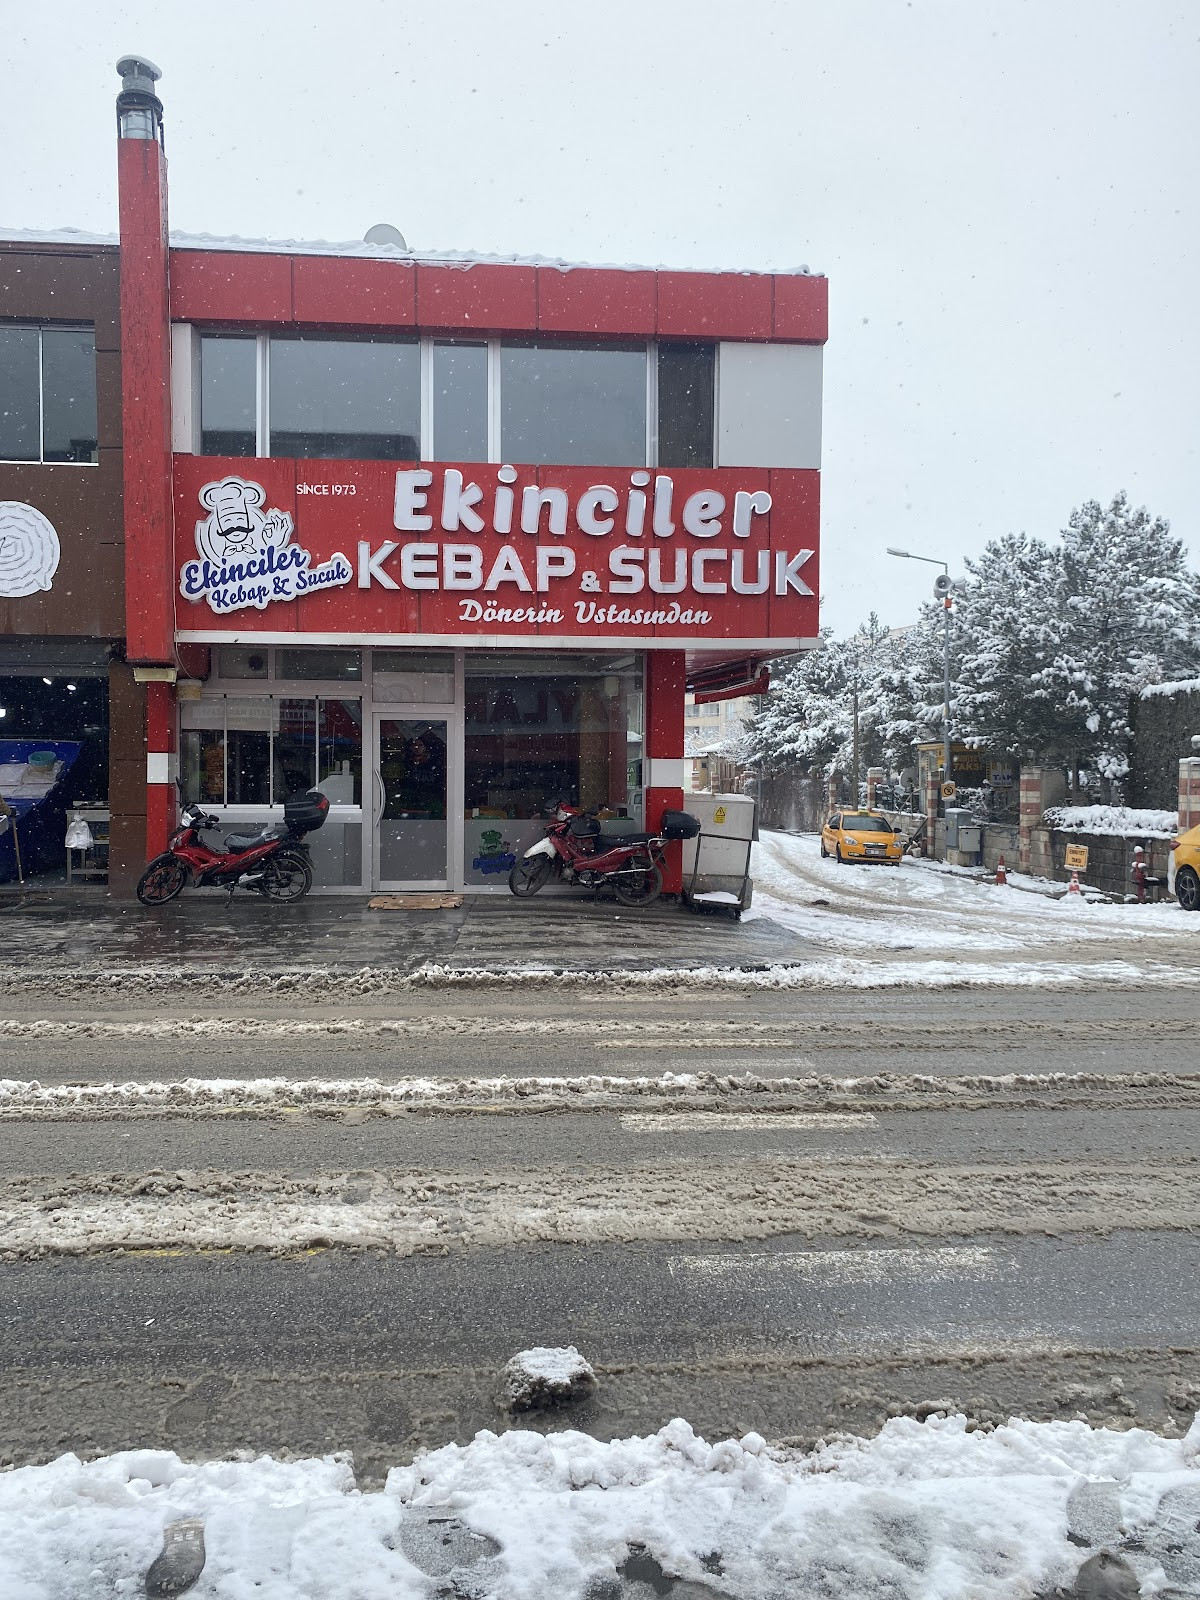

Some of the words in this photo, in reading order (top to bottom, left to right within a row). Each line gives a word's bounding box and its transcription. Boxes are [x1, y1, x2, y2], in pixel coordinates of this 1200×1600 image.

[332, 484, 356, 496] 1973
[393, 465, 773, 539] Ekinciler
[185, 545, 308, 594] Ekinciler
[212, 583, 270, 609] Kebap
[272, 577, 291, 595] &
[295, 561, 349, 590] Sucuk
[357, 540, 577, 593] KEBAP
[580, 571, 602, 592] &
[608, 543, 816, 596] SUCUK
[458, 598, 564, 624] Dönerin
[573, 600, 712, 626] Ustasından
